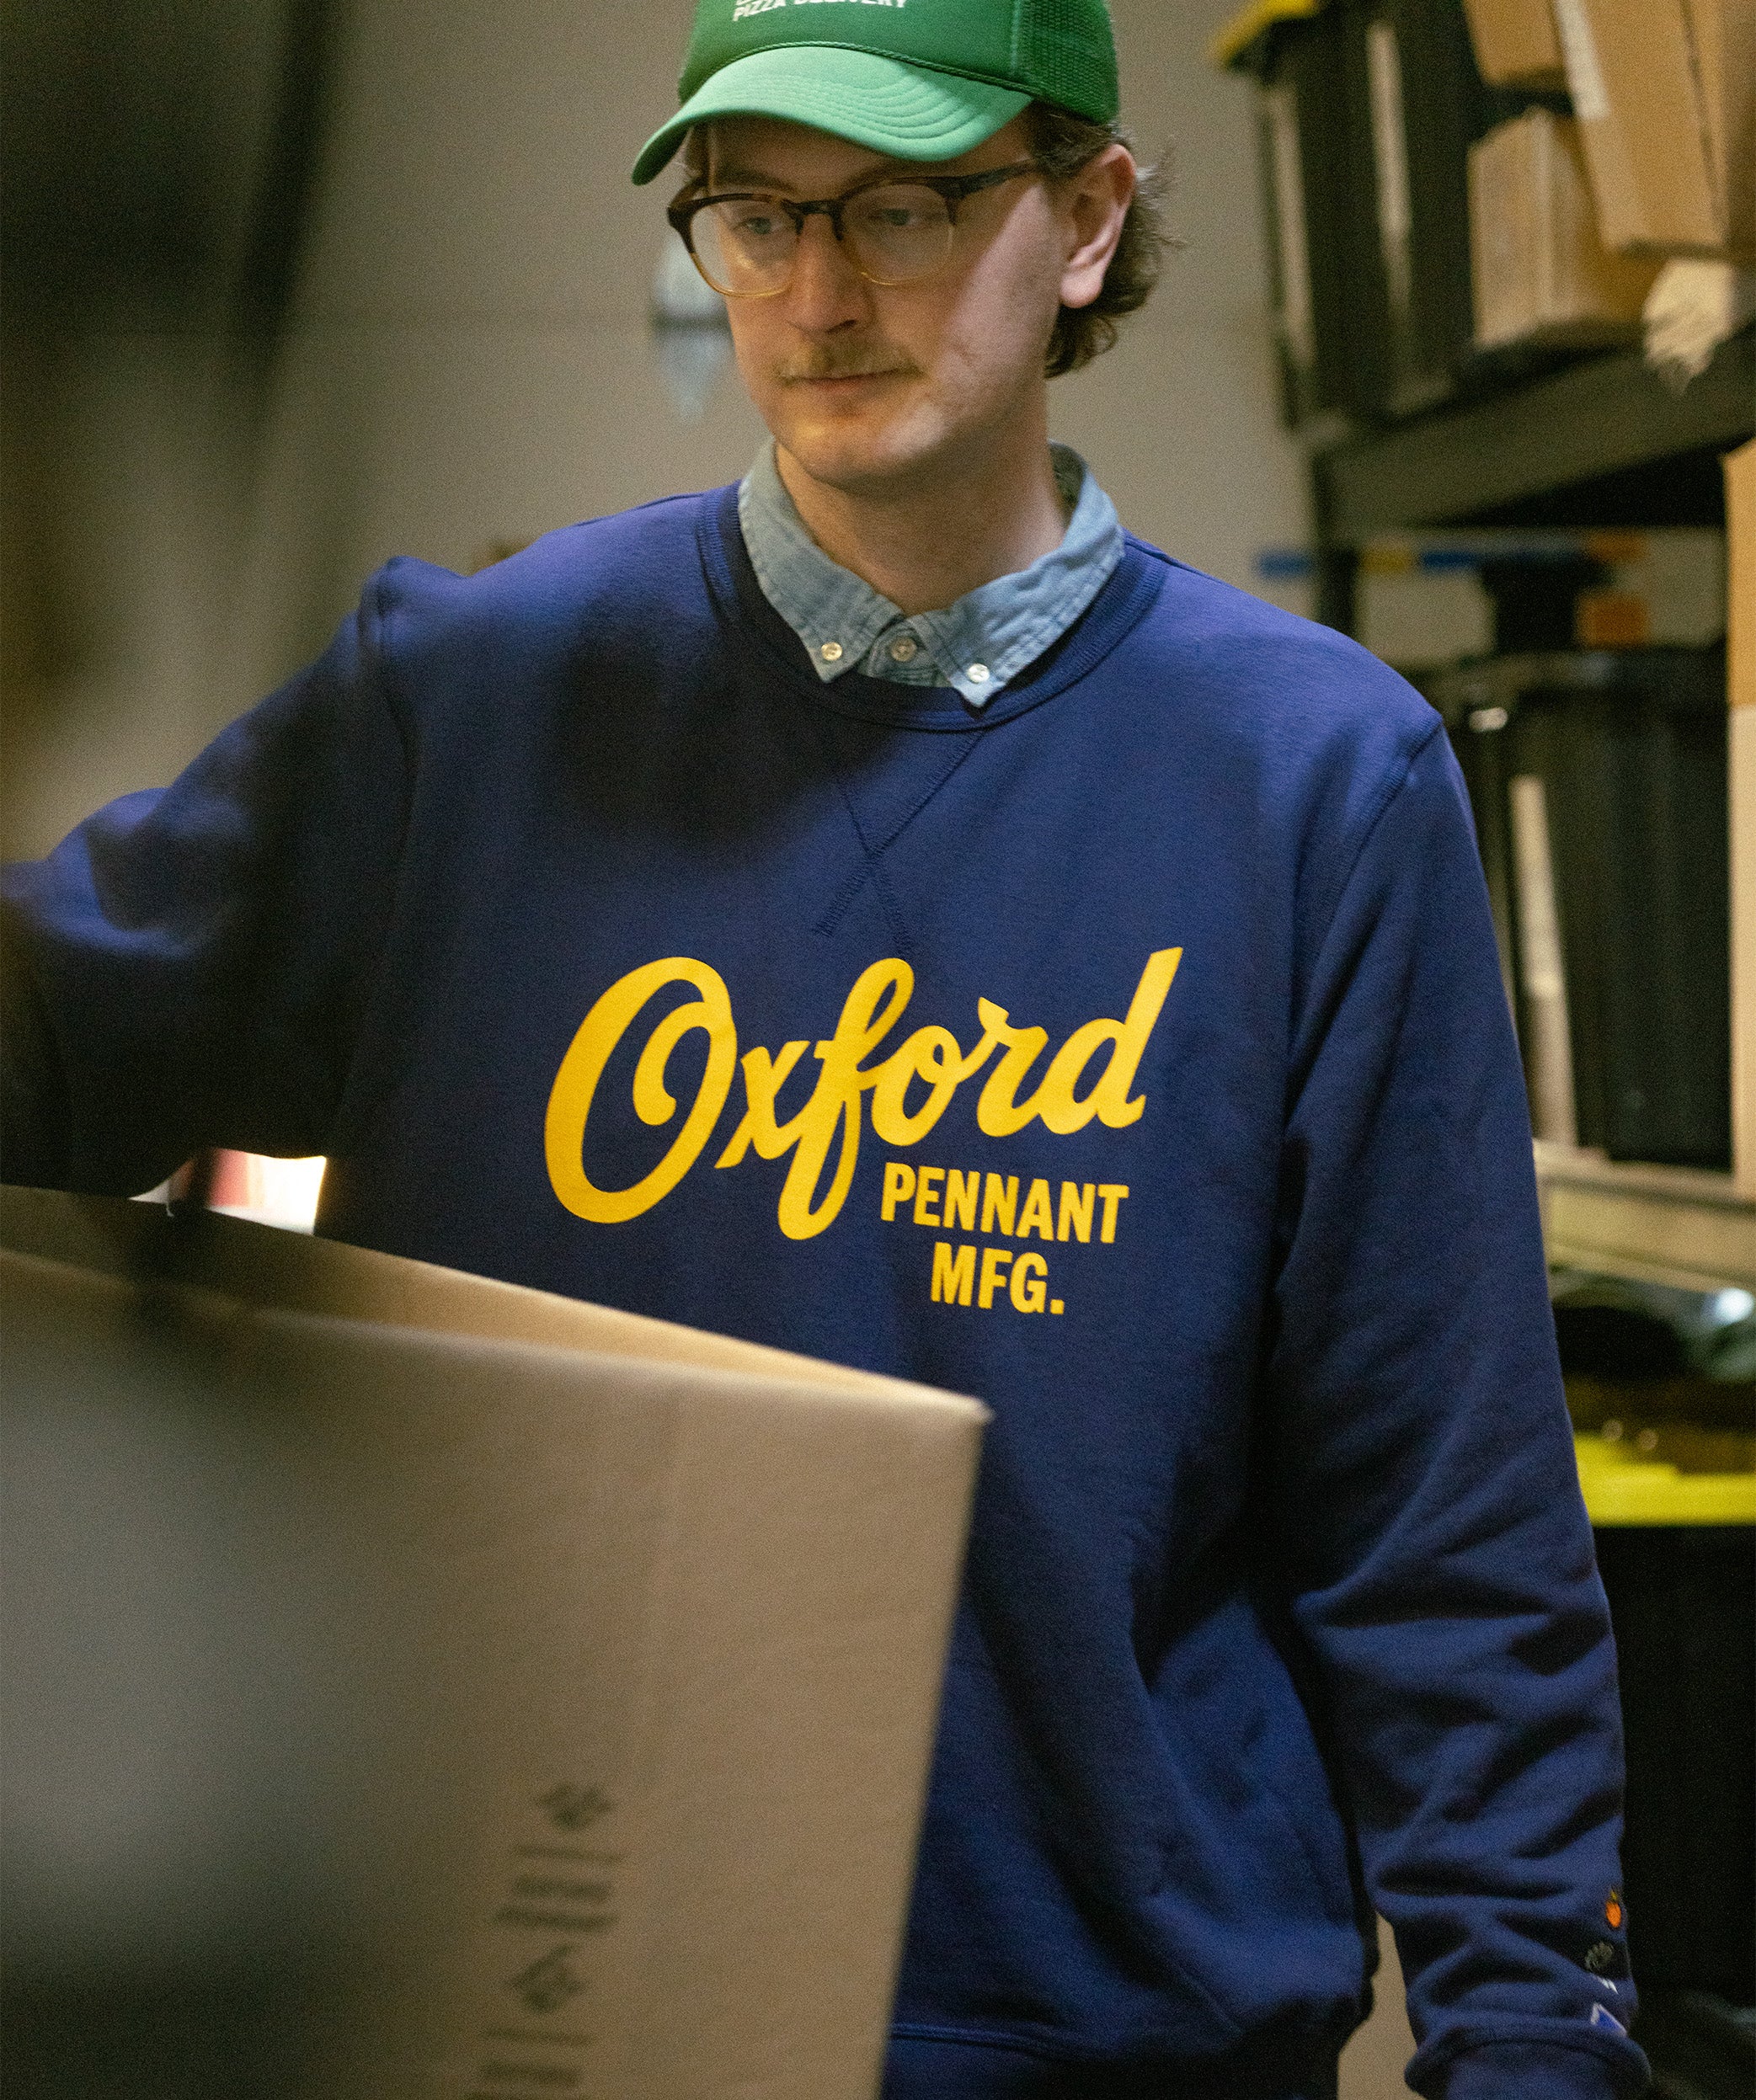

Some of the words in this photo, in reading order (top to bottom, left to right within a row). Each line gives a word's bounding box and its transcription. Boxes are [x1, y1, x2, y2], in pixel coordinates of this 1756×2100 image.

[544, 947, 1183, 1240] Oxford
[880, 1162, 1129, 1244] PENNANT
[931, 1241, 1065, 1315] MFG.
